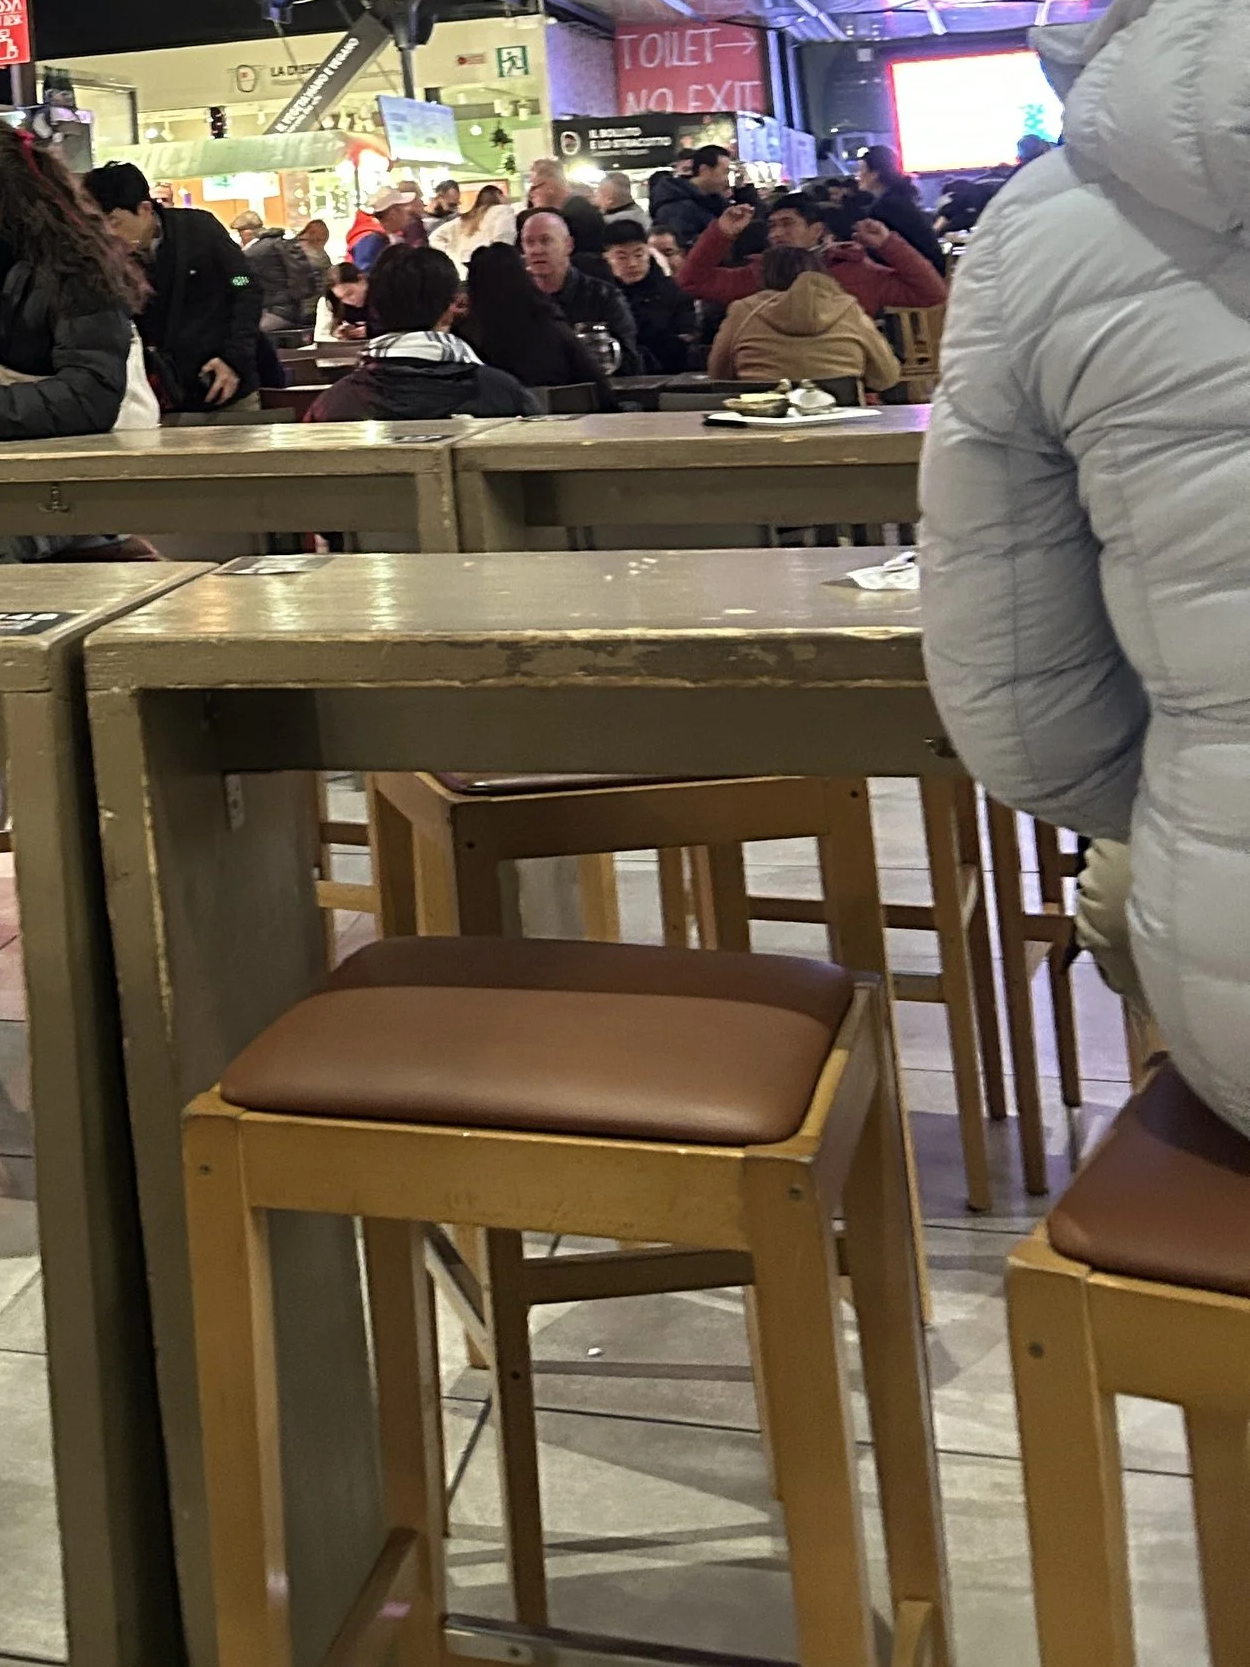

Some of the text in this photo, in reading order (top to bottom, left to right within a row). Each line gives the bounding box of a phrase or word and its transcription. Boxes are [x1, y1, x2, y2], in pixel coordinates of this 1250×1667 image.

[328, 37, 360, 70] VEGANO
[618, 27, 721, 70] TOILET
[624, 80, 763, 115] NO EXIT
